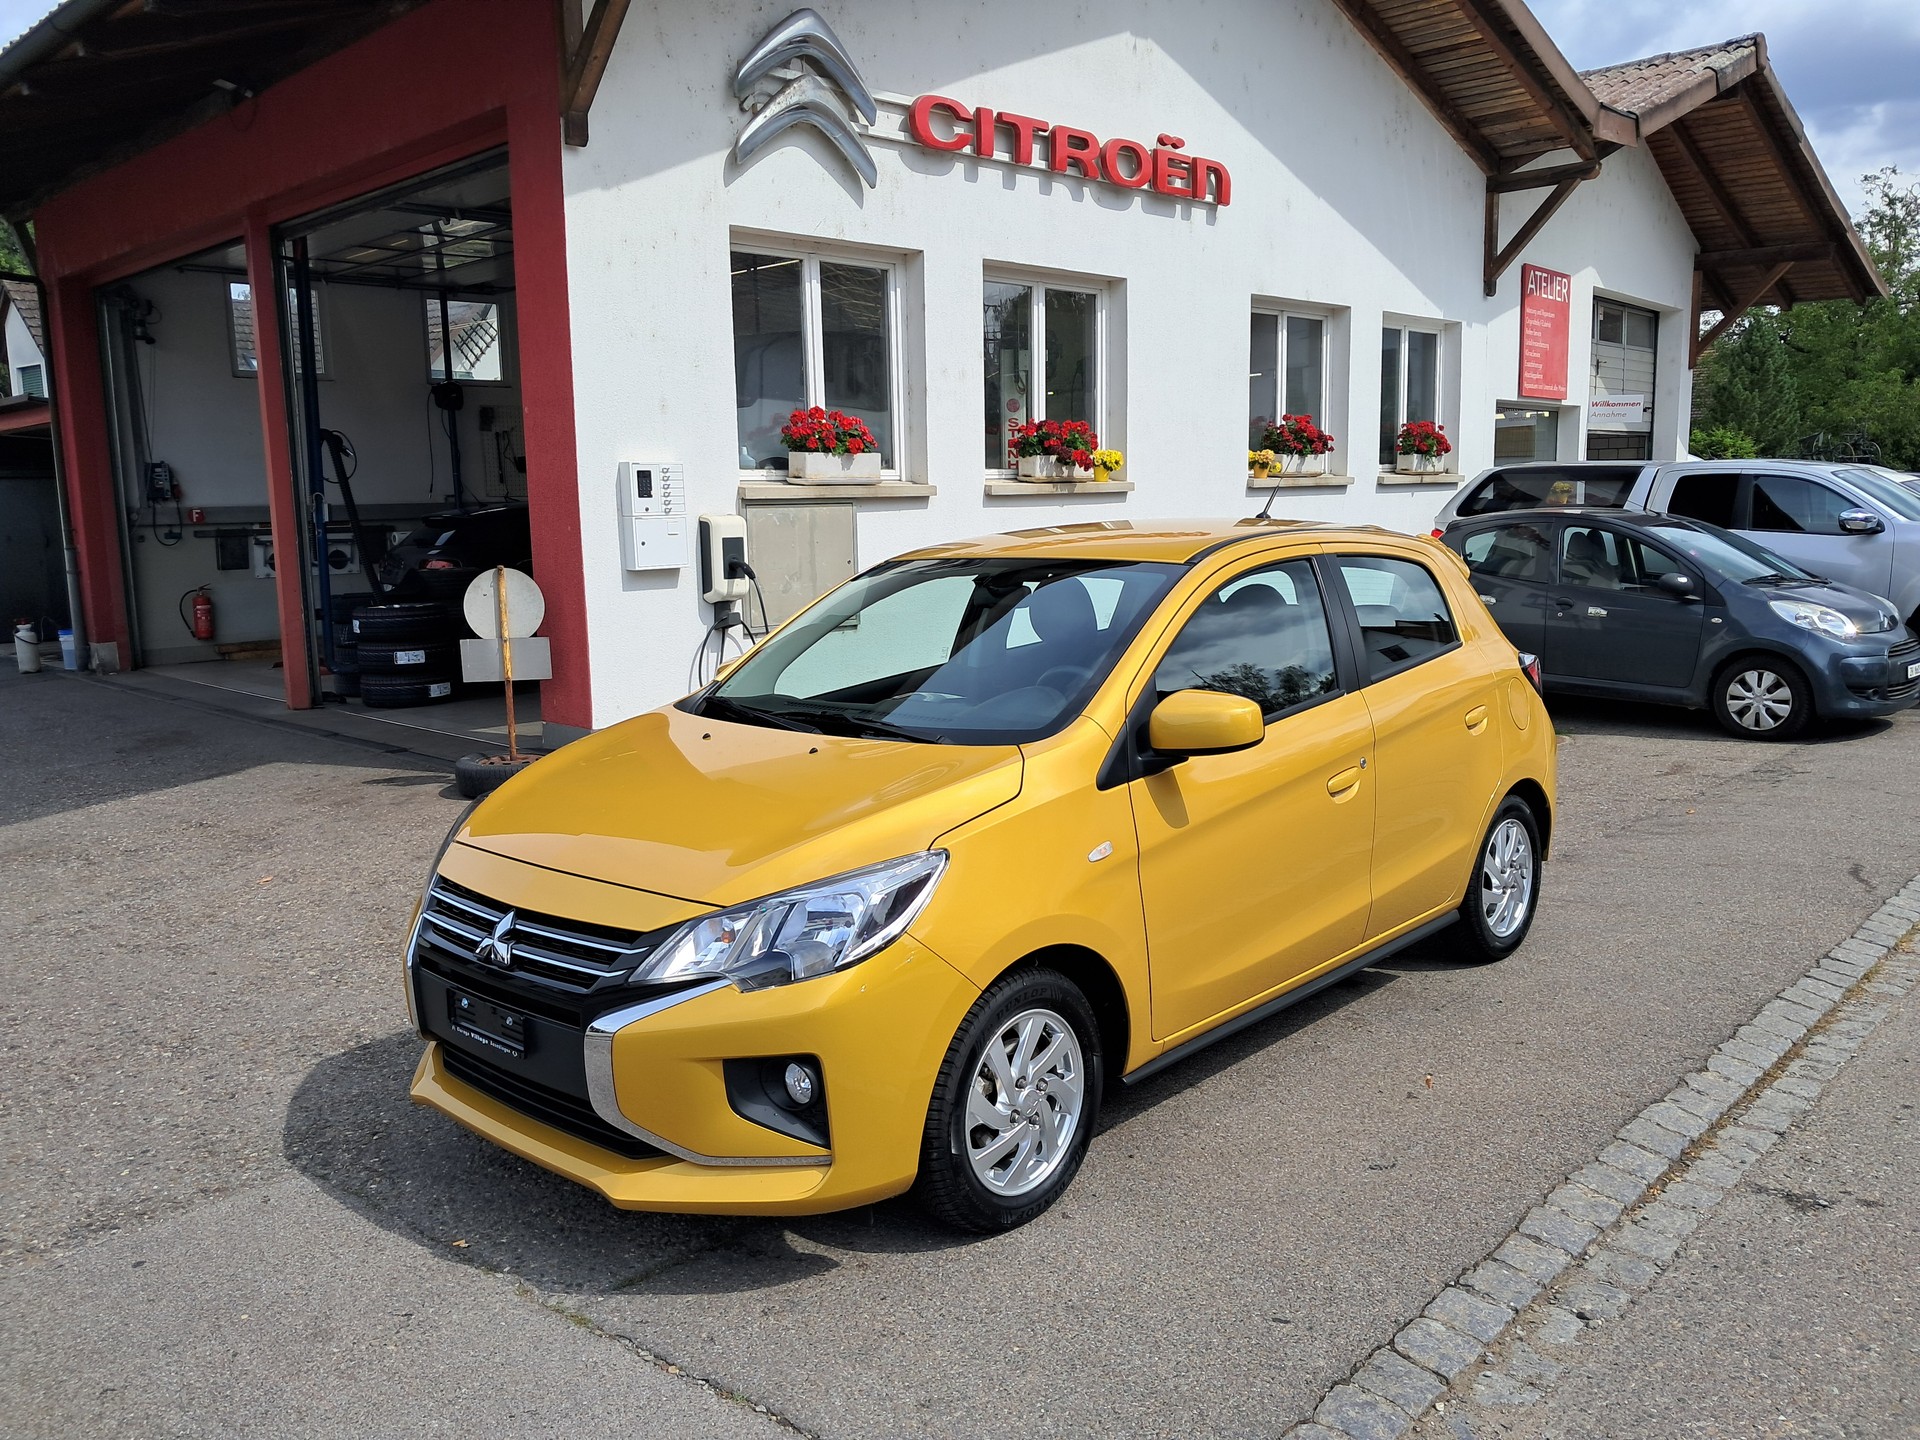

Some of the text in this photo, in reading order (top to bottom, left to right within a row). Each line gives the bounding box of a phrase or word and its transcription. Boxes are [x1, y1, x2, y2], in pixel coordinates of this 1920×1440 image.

[1527, 269, 1569, 303] ATELIER
[1591, 400, 1642, 408] Willkommen
[192, 509, 201, 522] F
[996, 987, 1048, 1020] DUNLOP
